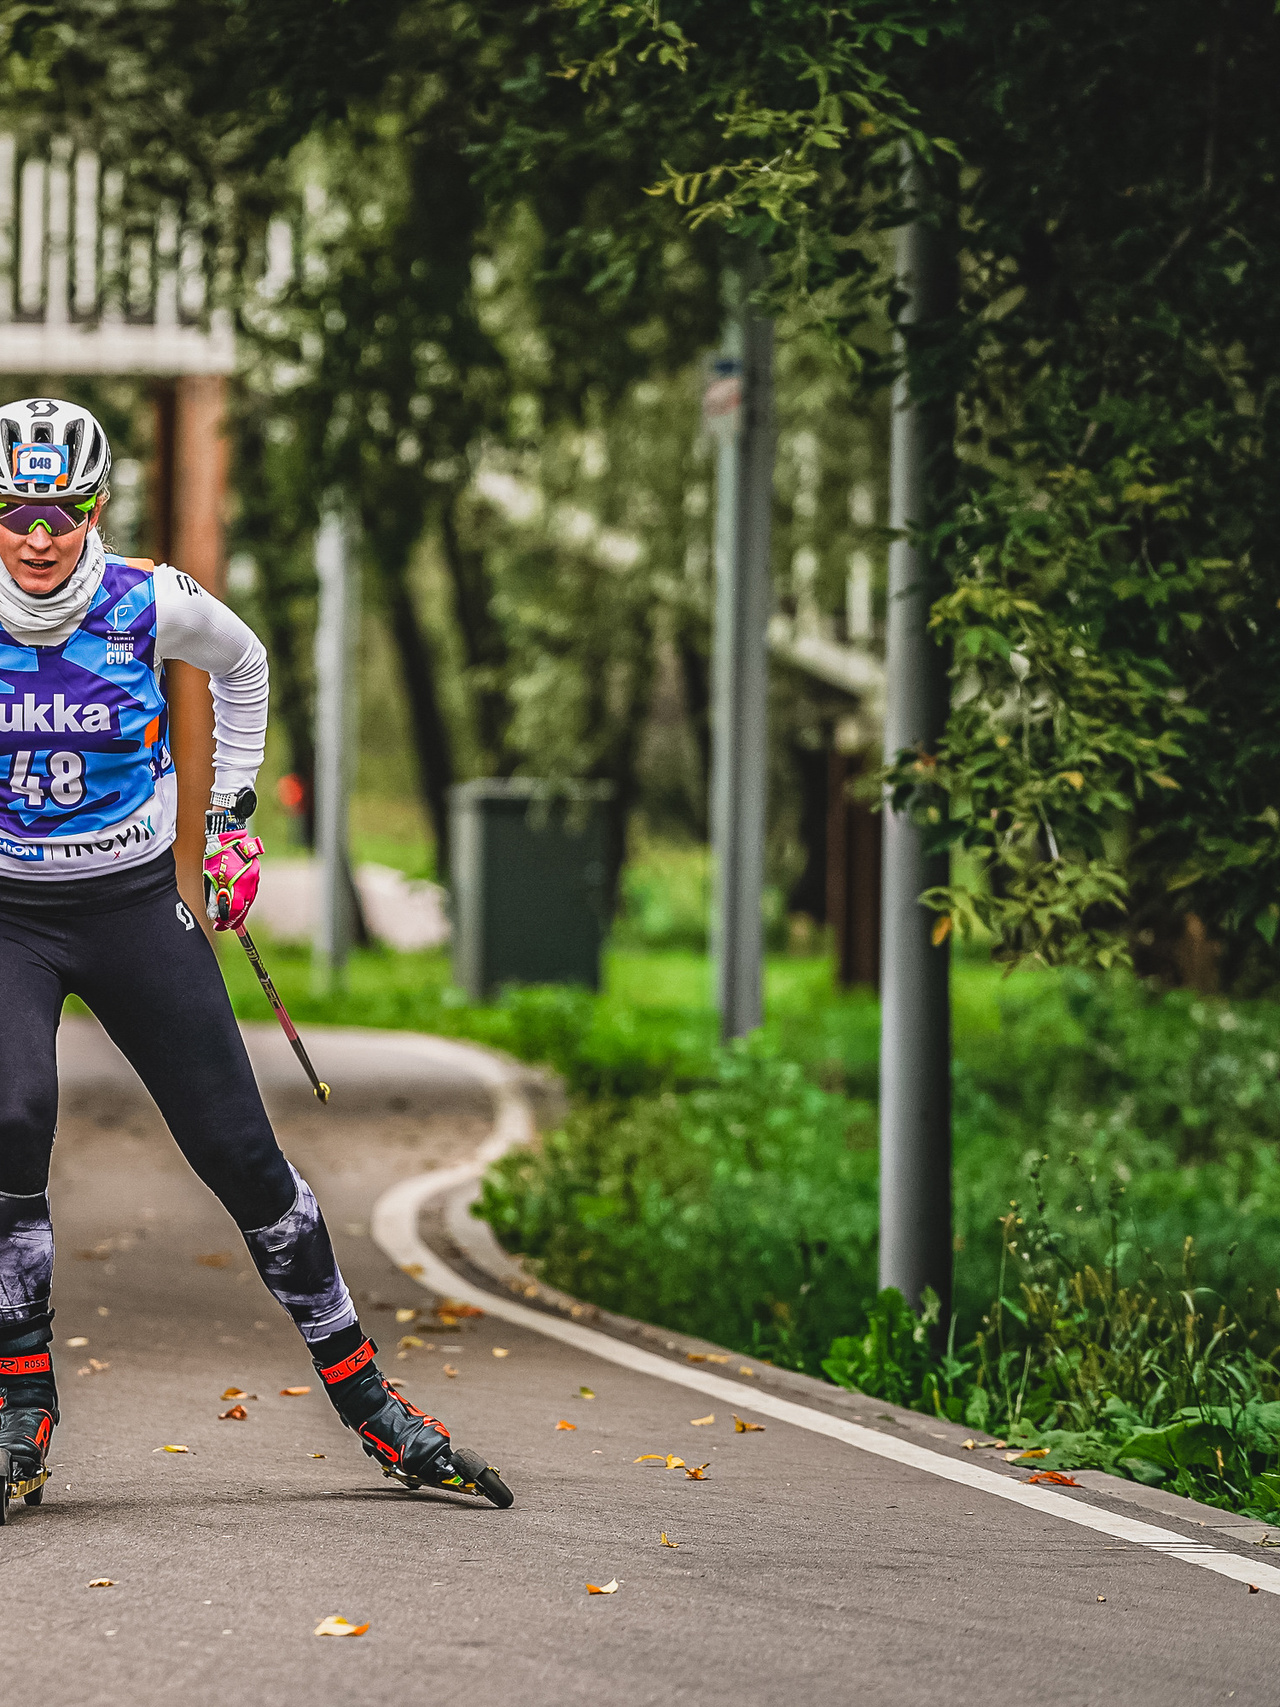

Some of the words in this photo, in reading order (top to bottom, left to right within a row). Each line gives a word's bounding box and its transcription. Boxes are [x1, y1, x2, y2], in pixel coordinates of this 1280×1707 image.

[29, 457, 51, 469] 048
[106, 651, 134, 665] CUP
[9, 750, 83, 805] 48
